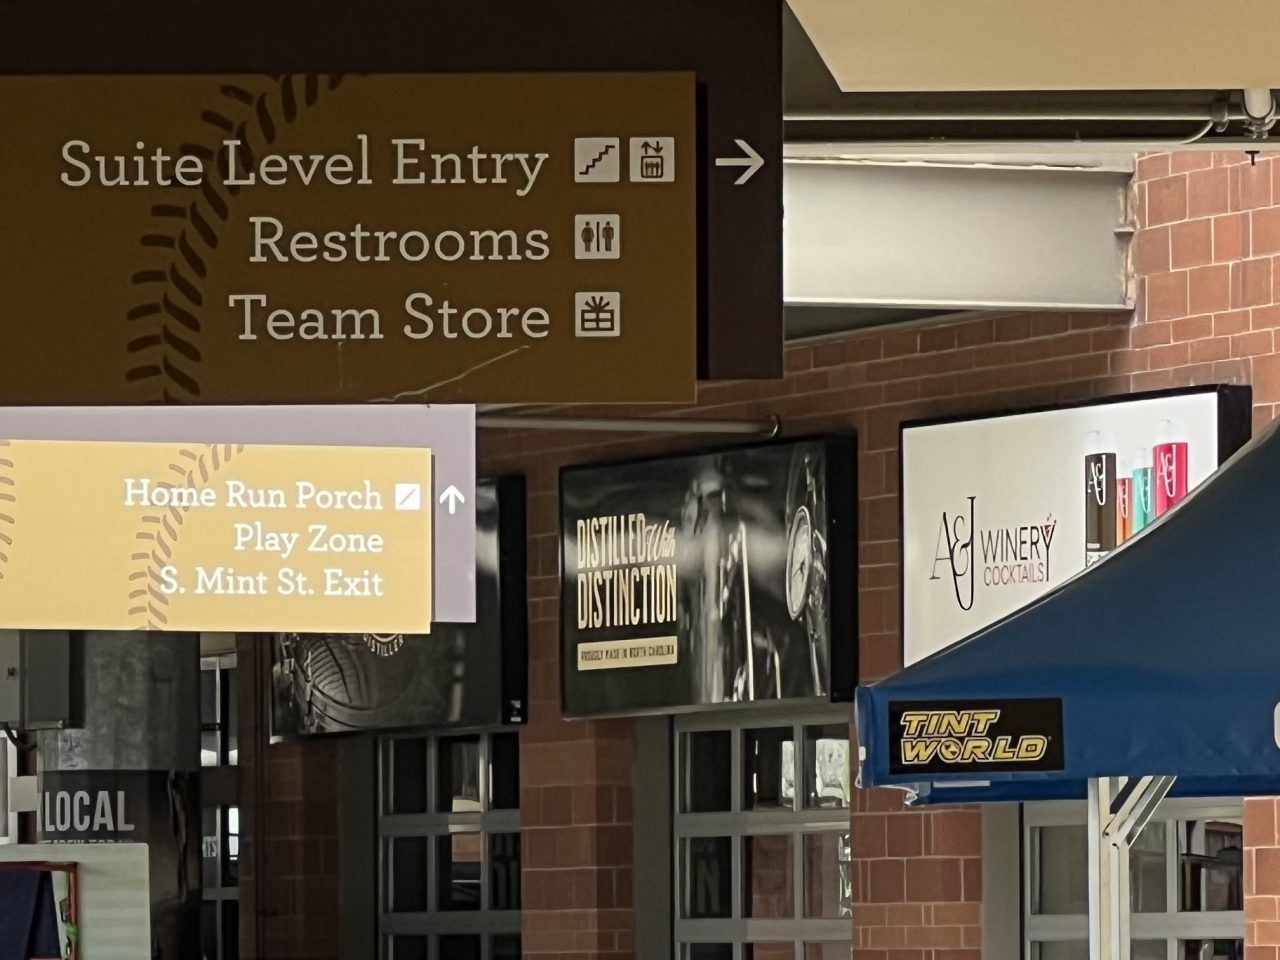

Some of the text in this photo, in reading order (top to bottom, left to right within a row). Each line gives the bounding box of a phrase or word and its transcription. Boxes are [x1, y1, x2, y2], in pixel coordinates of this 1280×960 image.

[60, 134, 549, 196] Suite Level Entry
[248, 215, 551, 263] Restrooms
[228, 292, 551, 341] Team Store
[123, 478, 383, 511] Home Run Porch
[233, 521, 384, 560] Play Zone
[577, 513, 645, 569] DISTILLED
[980, 519, 1057, 582] WINERY
[160, 565, 383, 597] S. Mint St. Exit
[984, 562, 1045, 586] COCKTAILS
[577, 564, 677, 629] DISTINCTION
[900, 709, 1001, 738] TINT
[900, 734, 1048, 764] WORLD
[44, 790, 135, 832] LOCAL
